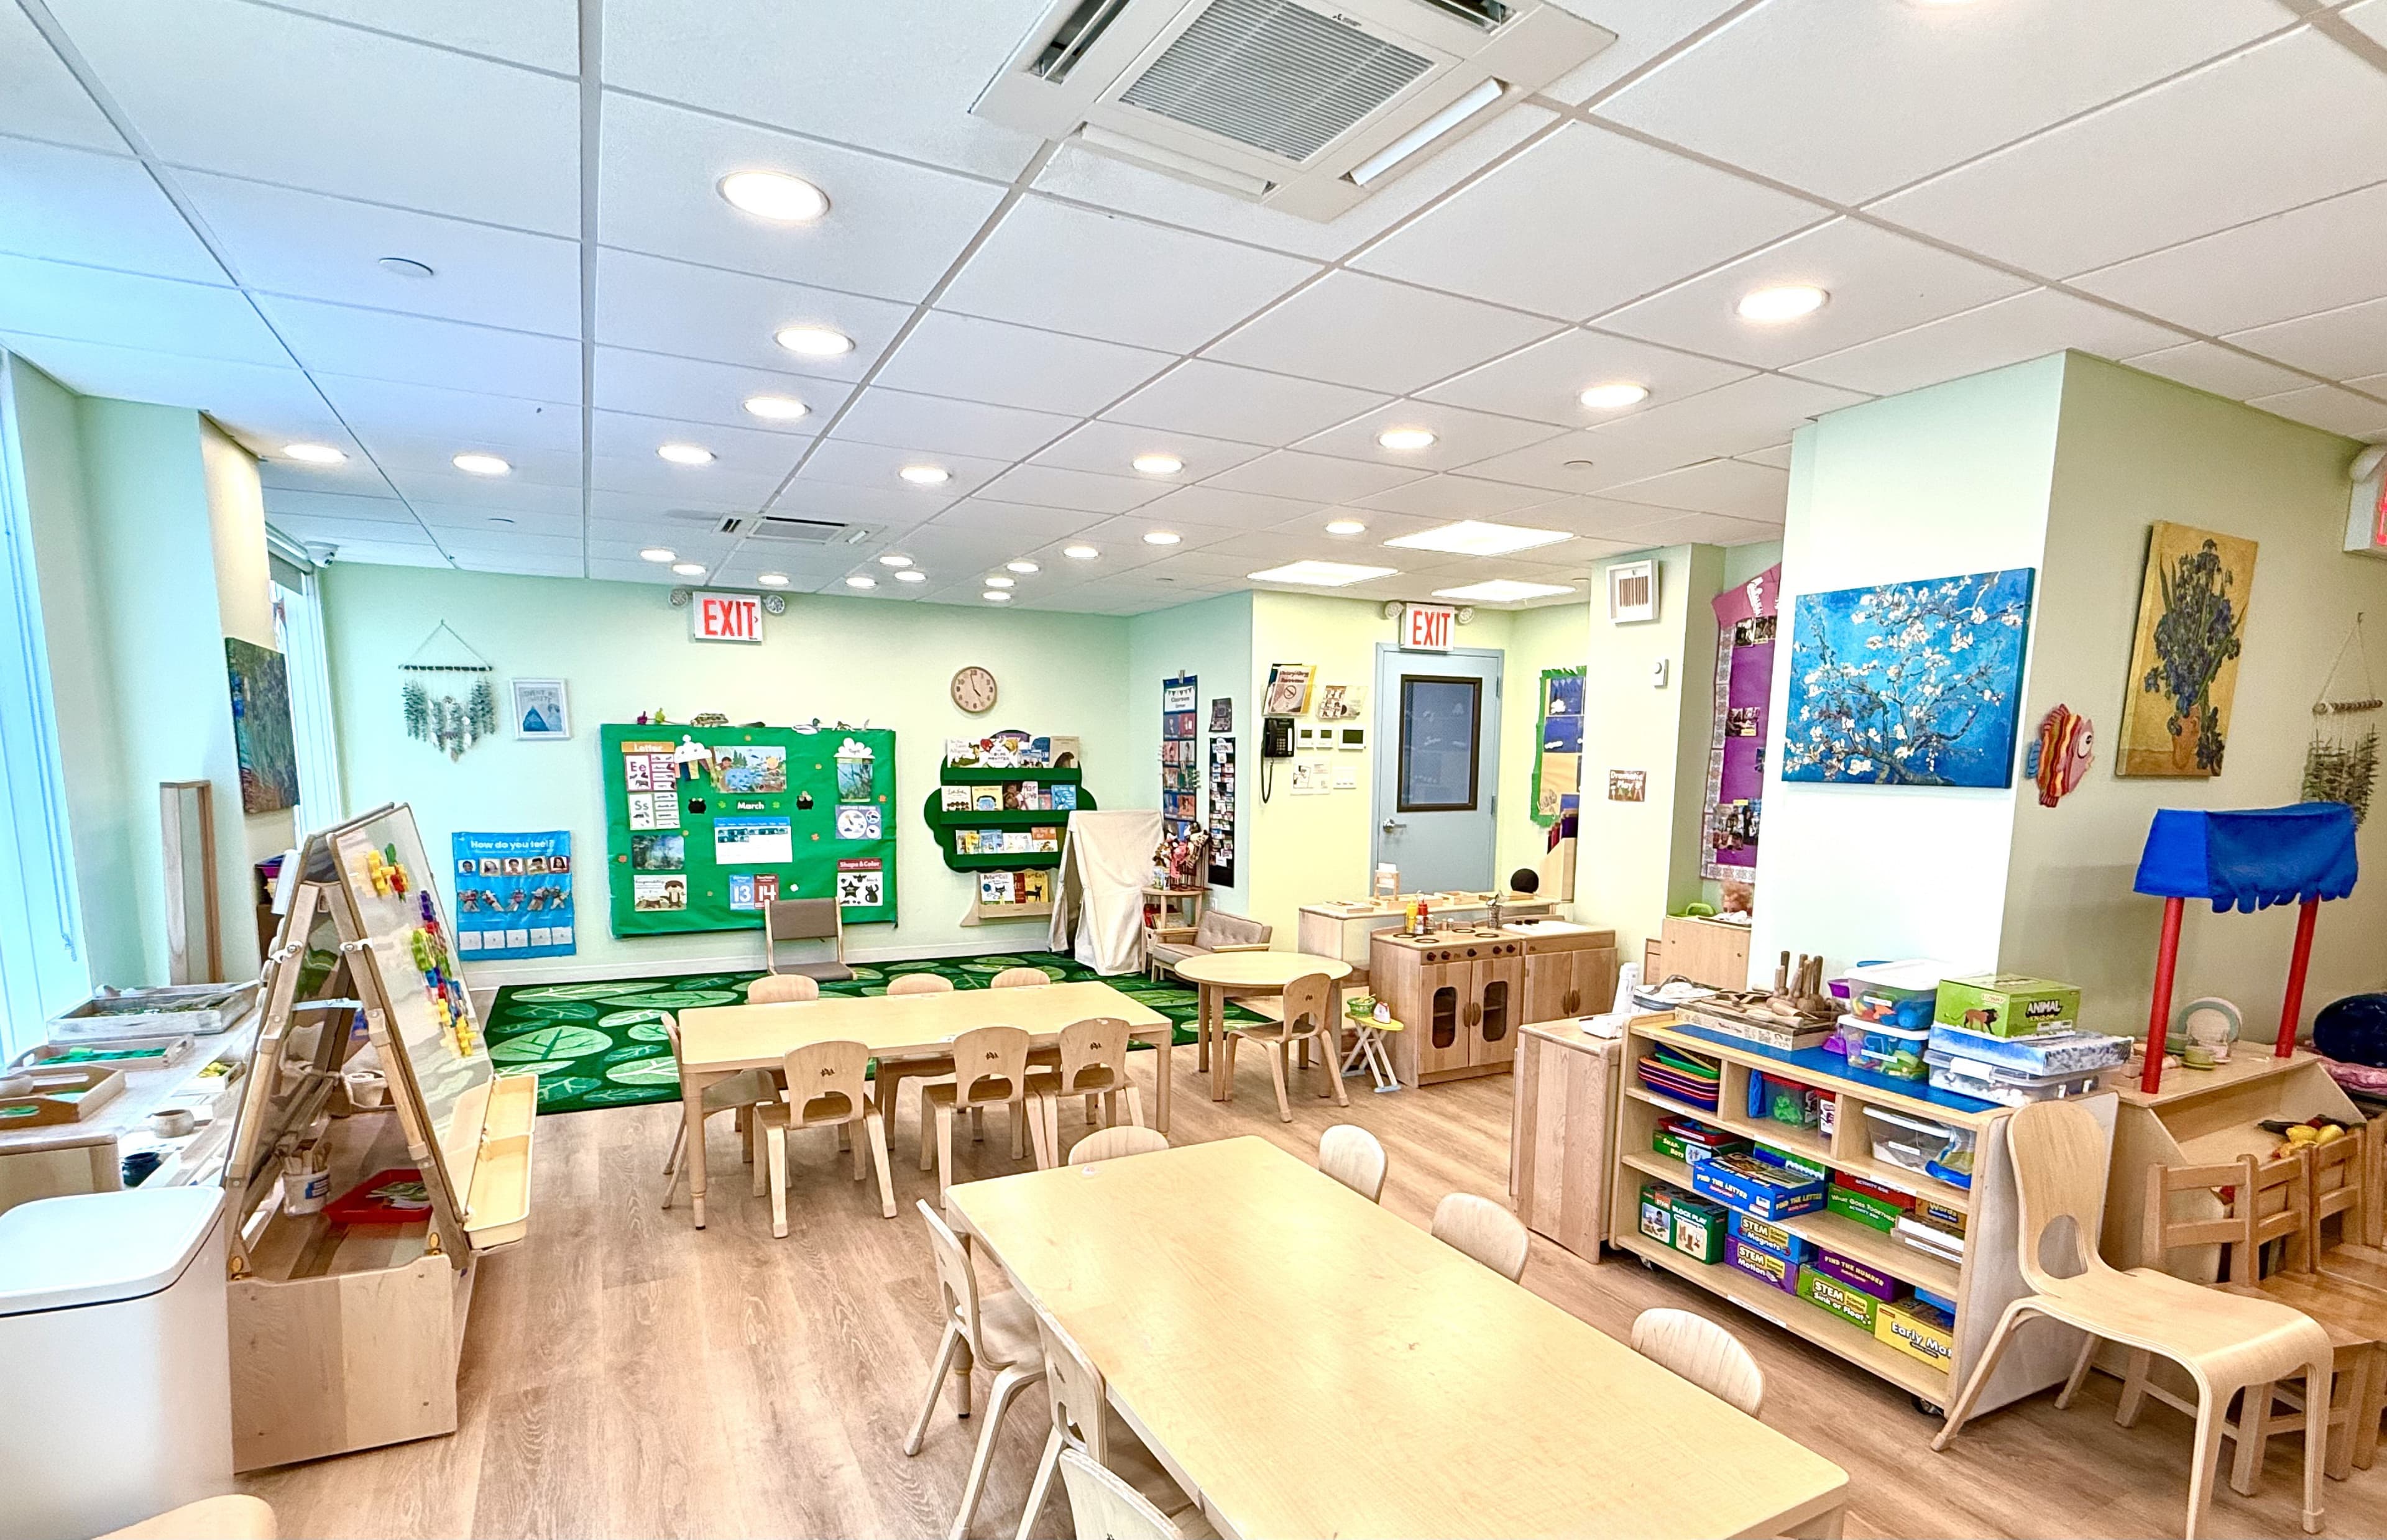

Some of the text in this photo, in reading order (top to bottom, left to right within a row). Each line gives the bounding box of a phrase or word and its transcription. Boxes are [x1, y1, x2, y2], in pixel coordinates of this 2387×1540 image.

[702, 598, 755, 637] EXIT
[1412, 610, 1450, 646] EXIT
[630, 761, 646, 772] Ee
[635, 800, 649, 810] Ss
[737, 801, 765, 810] March
[510, 842, 528, 850] you
[734, 885, 751, 902] 13
[759, 884, 776, 901] 14
[2028, 1000, 2061, 1014] ANIMAL
[1696, 1174, 1710, 1183] FIND
[1712, 1178, 1724, 1188] THE
[1725, 1183, 1748, 1200] LETTER
[1856, 1179, 1877, 1189] ACTIVITY
[1776, 1201, 1789, 1210] FIND
[1803, 1193, 1823, 1201] LETTER
[1929, 1203, 1957, 1217] Words
[1672, 1205, 1707, 1224] BLOCK PLAY
[1742, 1218, 1768, 1236] STEM
[1747, 1231, 1781, 1250] Magnets
[1739, 1246, 1764, 1265] STEM
[1738, 1258, 1766, 1276] Motion
[1824, 1255, 1840, 1266] FIND
[1841, 1261, 1855, 1272] THE
[1856, 1266, 1884, 1286] NUMBER
[1814, 1281, 1843, 1302] STEM
[1814, 1292, 1831, 1305] Sink
[1833, 1302, 1841, 1310] or
[1843, 1306, 1865, 1322] Float
[1892, 1322, 1923, 1347] Early
